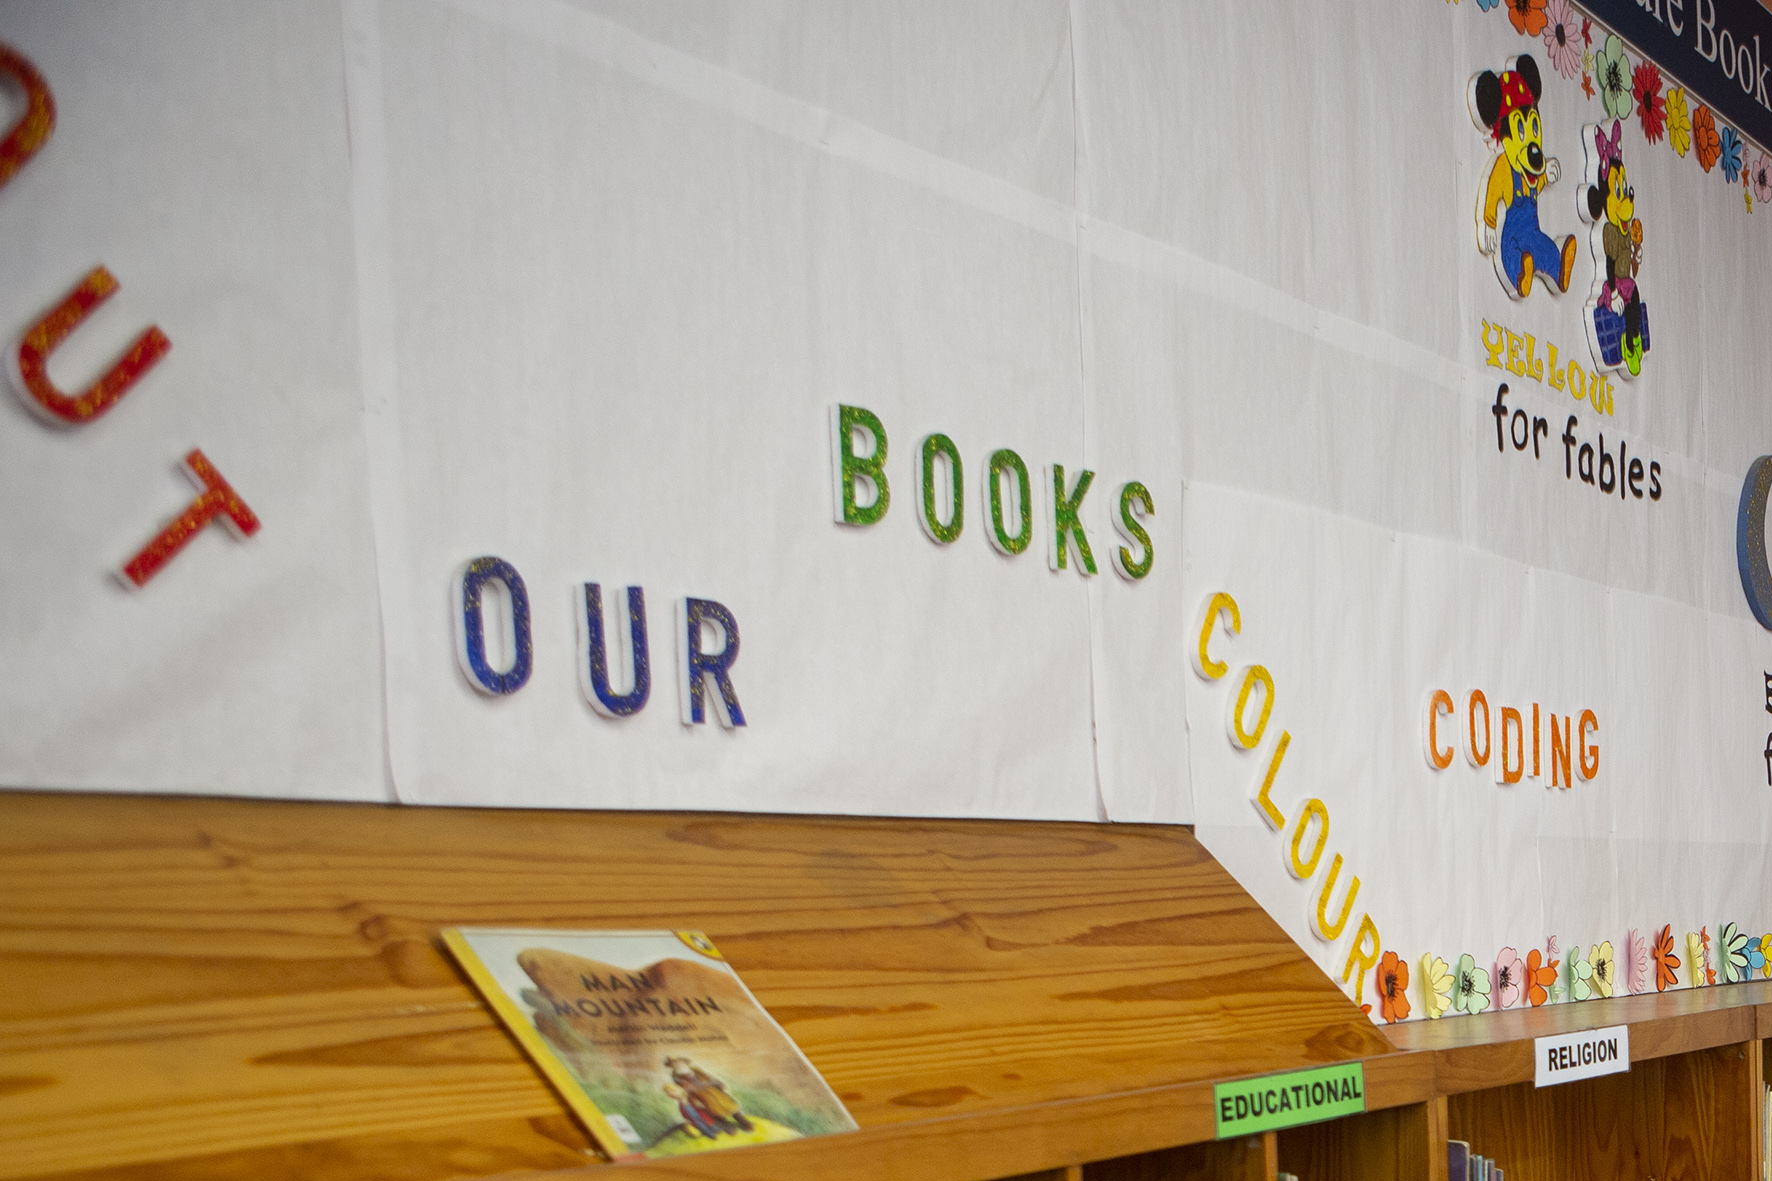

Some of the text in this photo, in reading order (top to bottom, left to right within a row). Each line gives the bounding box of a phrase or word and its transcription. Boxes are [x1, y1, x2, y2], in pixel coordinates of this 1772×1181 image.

[1481, 318, 1615, 417] YELLOW
[829, 403, 1155, 581] BOOKS
[1491, 382, 1663, 502] for fables
[452, 554, 748, 728] OUR
[1421, 688, 1600, 790] CODING
[1190, 591, 1381, 1006] COLOUR
[553, 995, 724, 1019] MOUNTAIN
[580, 971, 653, 993] MAN
[1220, 1076, 1362, 1123] EDUCATIONAL
[1548, 1038, 1618, 1072] RELIGION
